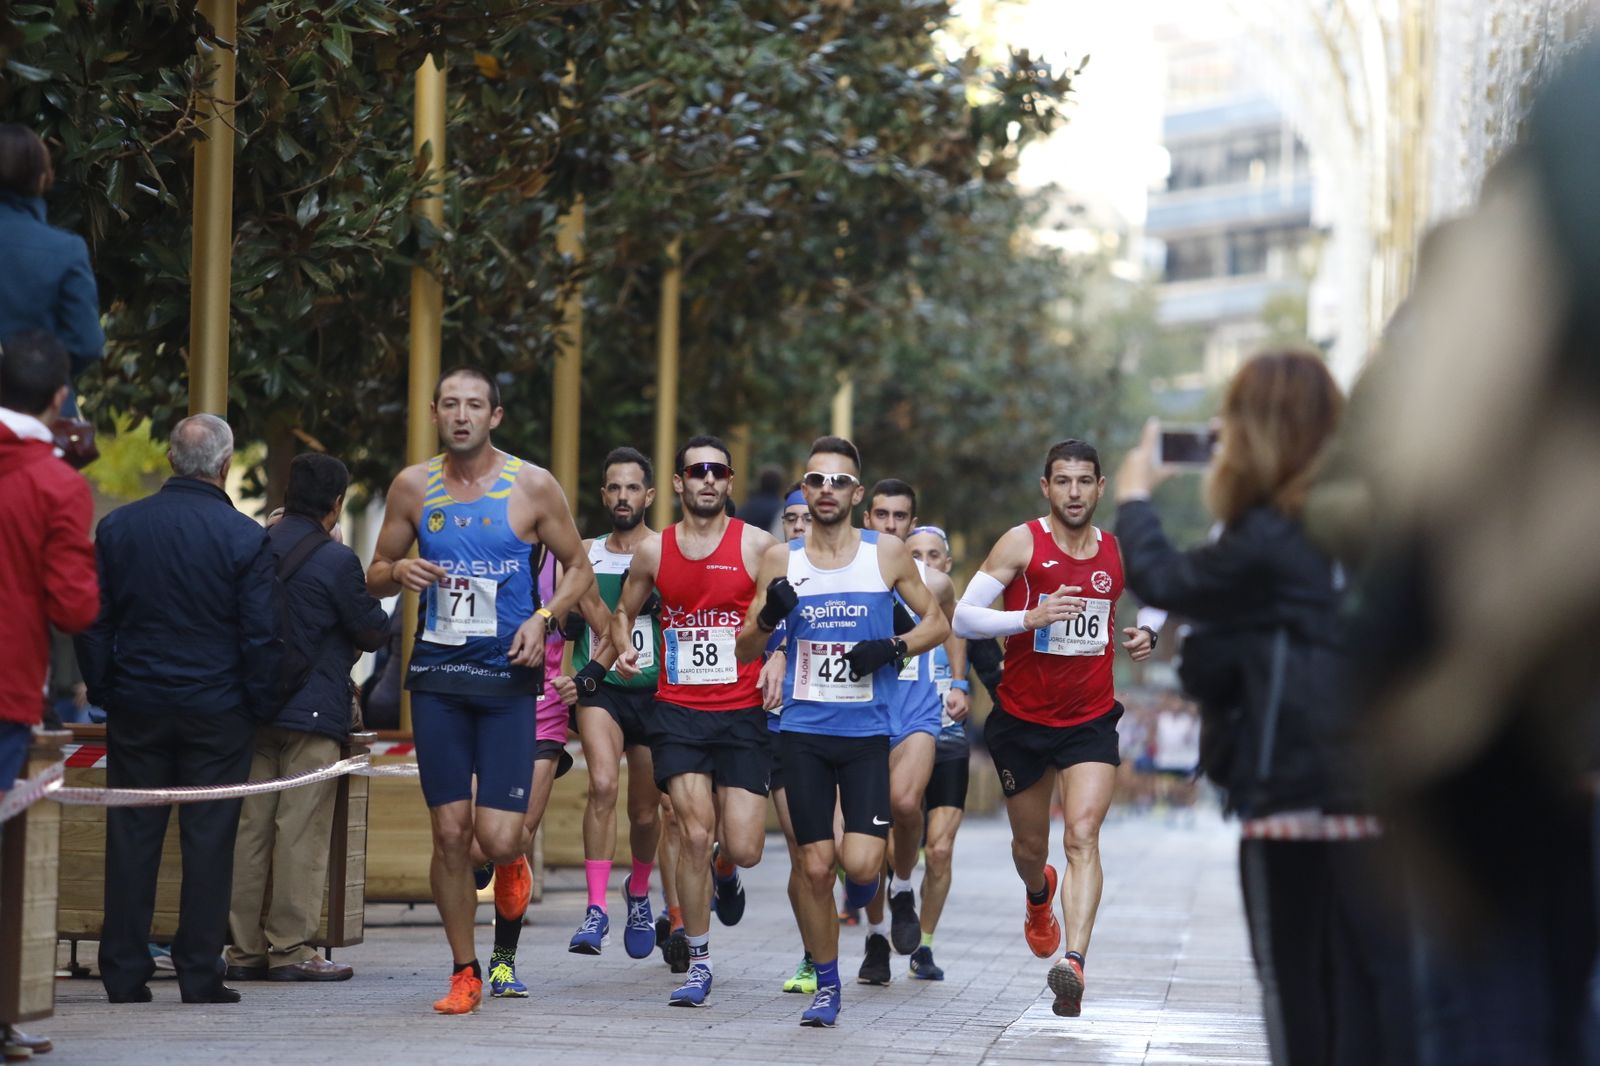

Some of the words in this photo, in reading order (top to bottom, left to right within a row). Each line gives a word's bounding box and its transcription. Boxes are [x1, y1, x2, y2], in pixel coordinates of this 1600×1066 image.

[449, 592, 475, 617] 71
[800, 605, 868, 623] Beiman
[1064, 612, 1100, 638] 106
[692, 642, 719, 667] 58
